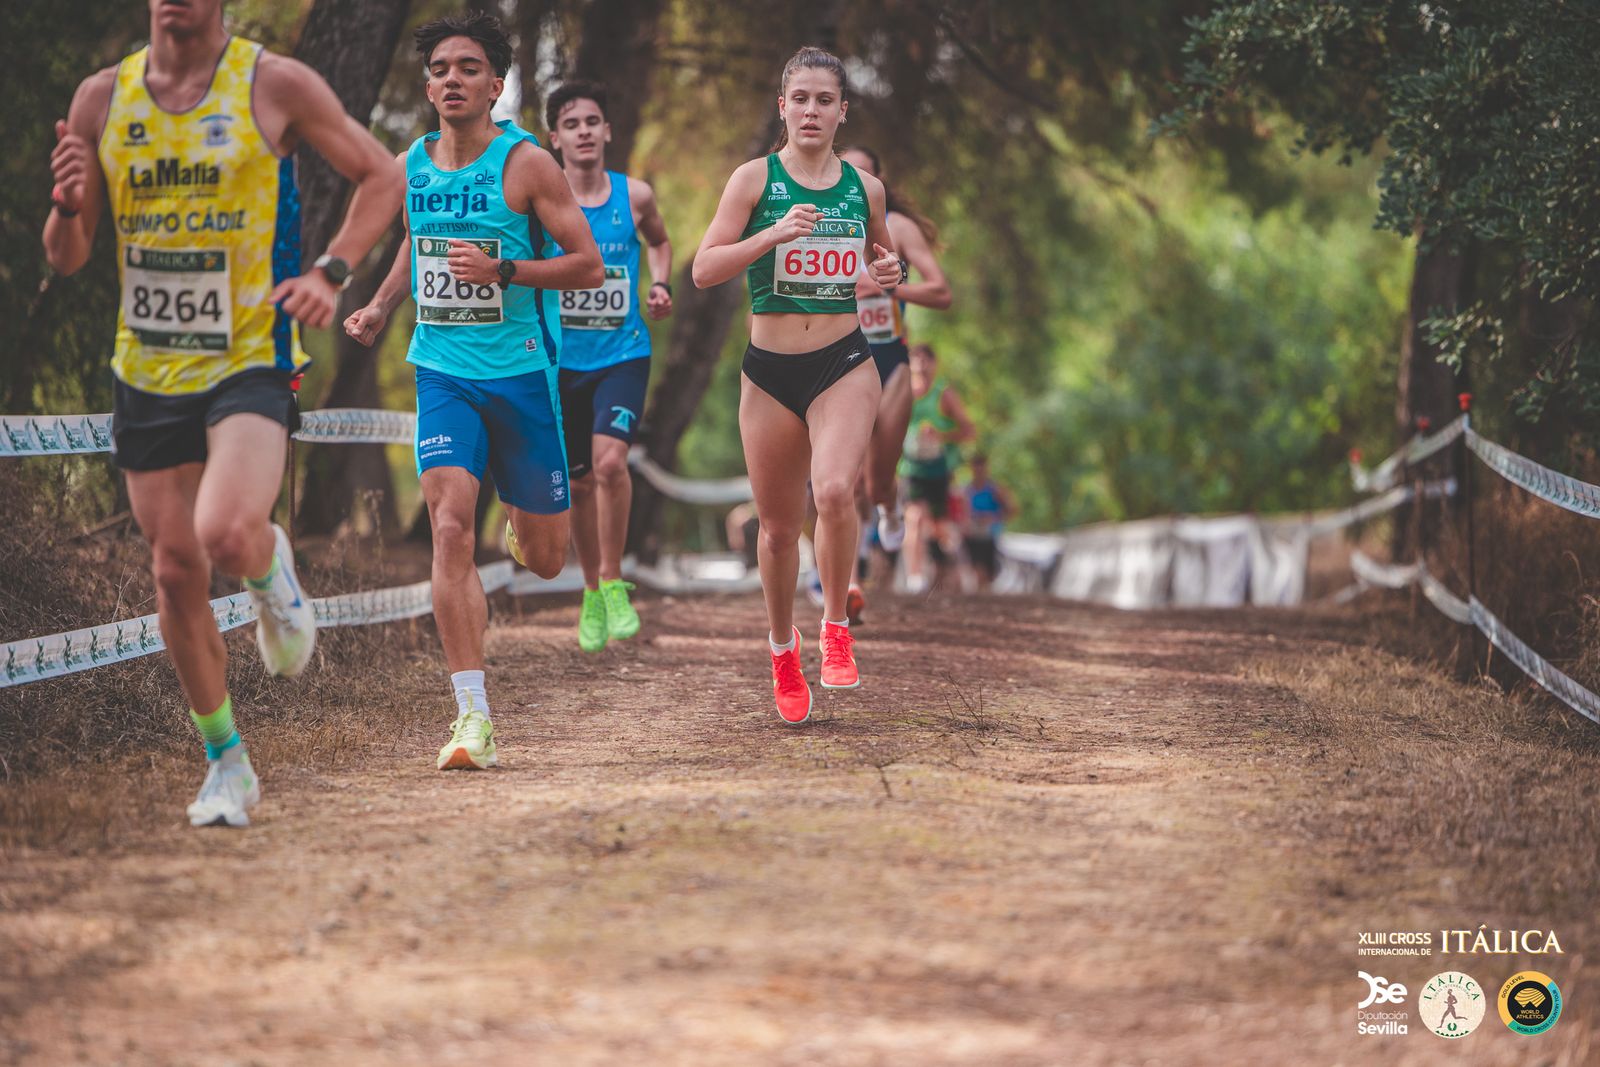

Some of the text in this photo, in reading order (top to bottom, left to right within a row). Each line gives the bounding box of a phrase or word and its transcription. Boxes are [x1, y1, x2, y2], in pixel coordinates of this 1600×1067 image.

[411, 185, 489, 219] nerja
[186, 205, 246, 232] CÁDIZ
[420, 222, 479, 234] ATLETISMO
[784, 249, 857, 277] 6300
[133, 286, 223, 323] 8264
[561, 290, 624, 311] 8290
[419, 434, 452, 447] nerja
